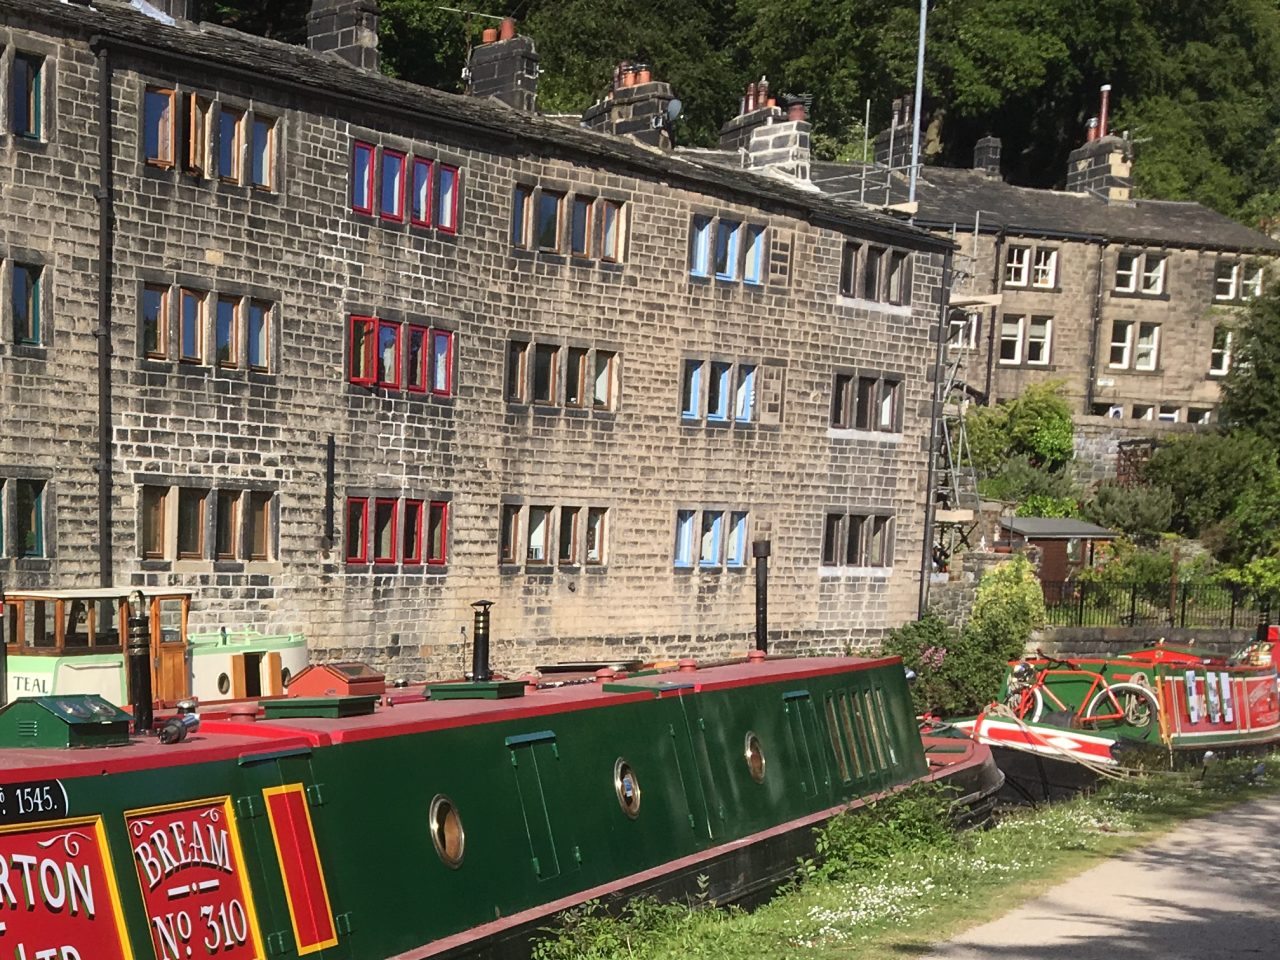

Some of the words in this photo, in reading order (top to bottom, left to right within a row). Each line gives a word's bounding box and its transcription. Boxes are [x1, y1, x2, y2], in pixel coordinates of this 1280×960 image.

[13, 675, 49, 694] TEAL
[134, 820, 234, 890] BREAM
[200, 898, 248, 952] 310
